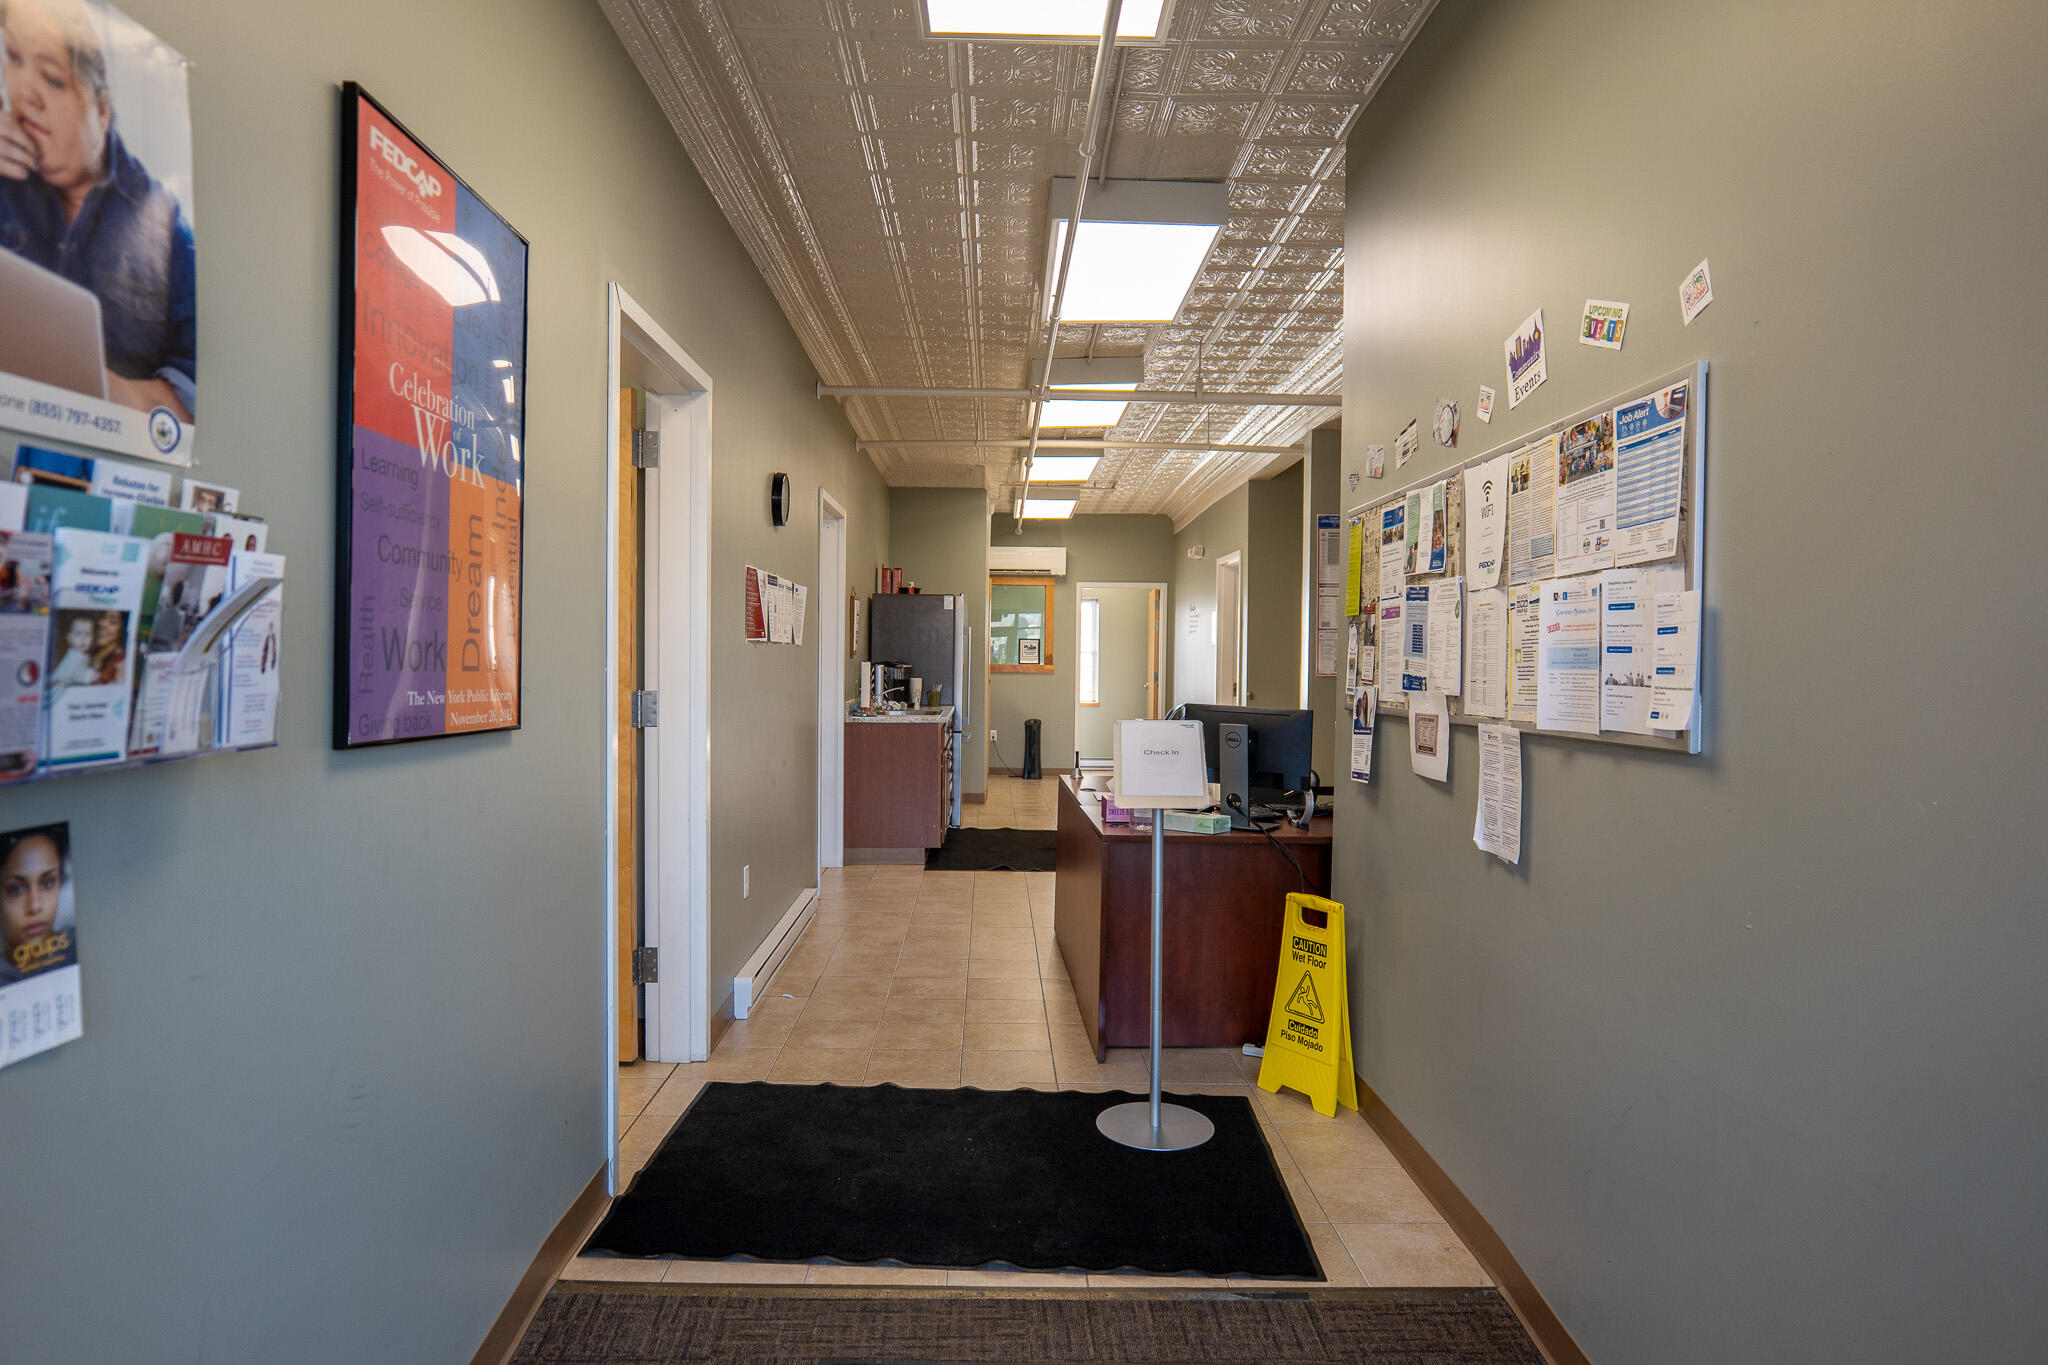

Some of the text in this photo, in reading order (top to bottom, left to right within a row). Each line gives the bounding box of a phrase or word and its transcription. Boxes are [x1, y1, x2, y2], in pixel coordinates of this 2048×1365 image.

[370, 125, 442, 197] FEDCAP
[1589, 305, 1623, 319] UPCOMING
[1584, 316, 1623, 341] EVENTS
[364, 290, 478, 393] Innovaton
[389, 361, 475, 431] Celebration
[1514, 371, 1541, 402] Events
[29, 399, 62, 420] (855)
[1619, 407, 1650, 425] Job Alert
[410, 402, 487, 490] Work
[453, 427, 463, 442] of
[361, 448, 418, 491] Learning
[181, 538, 223, 556] AMHC
[378, 534, 463, 582] Community
[462, 514, 483, 672] Dream
[360, 595, 375, 693] Health
[381, 625, 447, 673] Work
[408, 687, 512, 706] The New York Public Library
[358, 711, 432, 738] Giving back
[451, 711, 487, 727] November
[1292, 950, 1326, 969] Wet Floor
[1293, 937, 1327, 957] CAUTION
[1281, 1029, 1323, 1052] Piso Mojado
[1289, 1020, 1318, 1039] Cuidado
